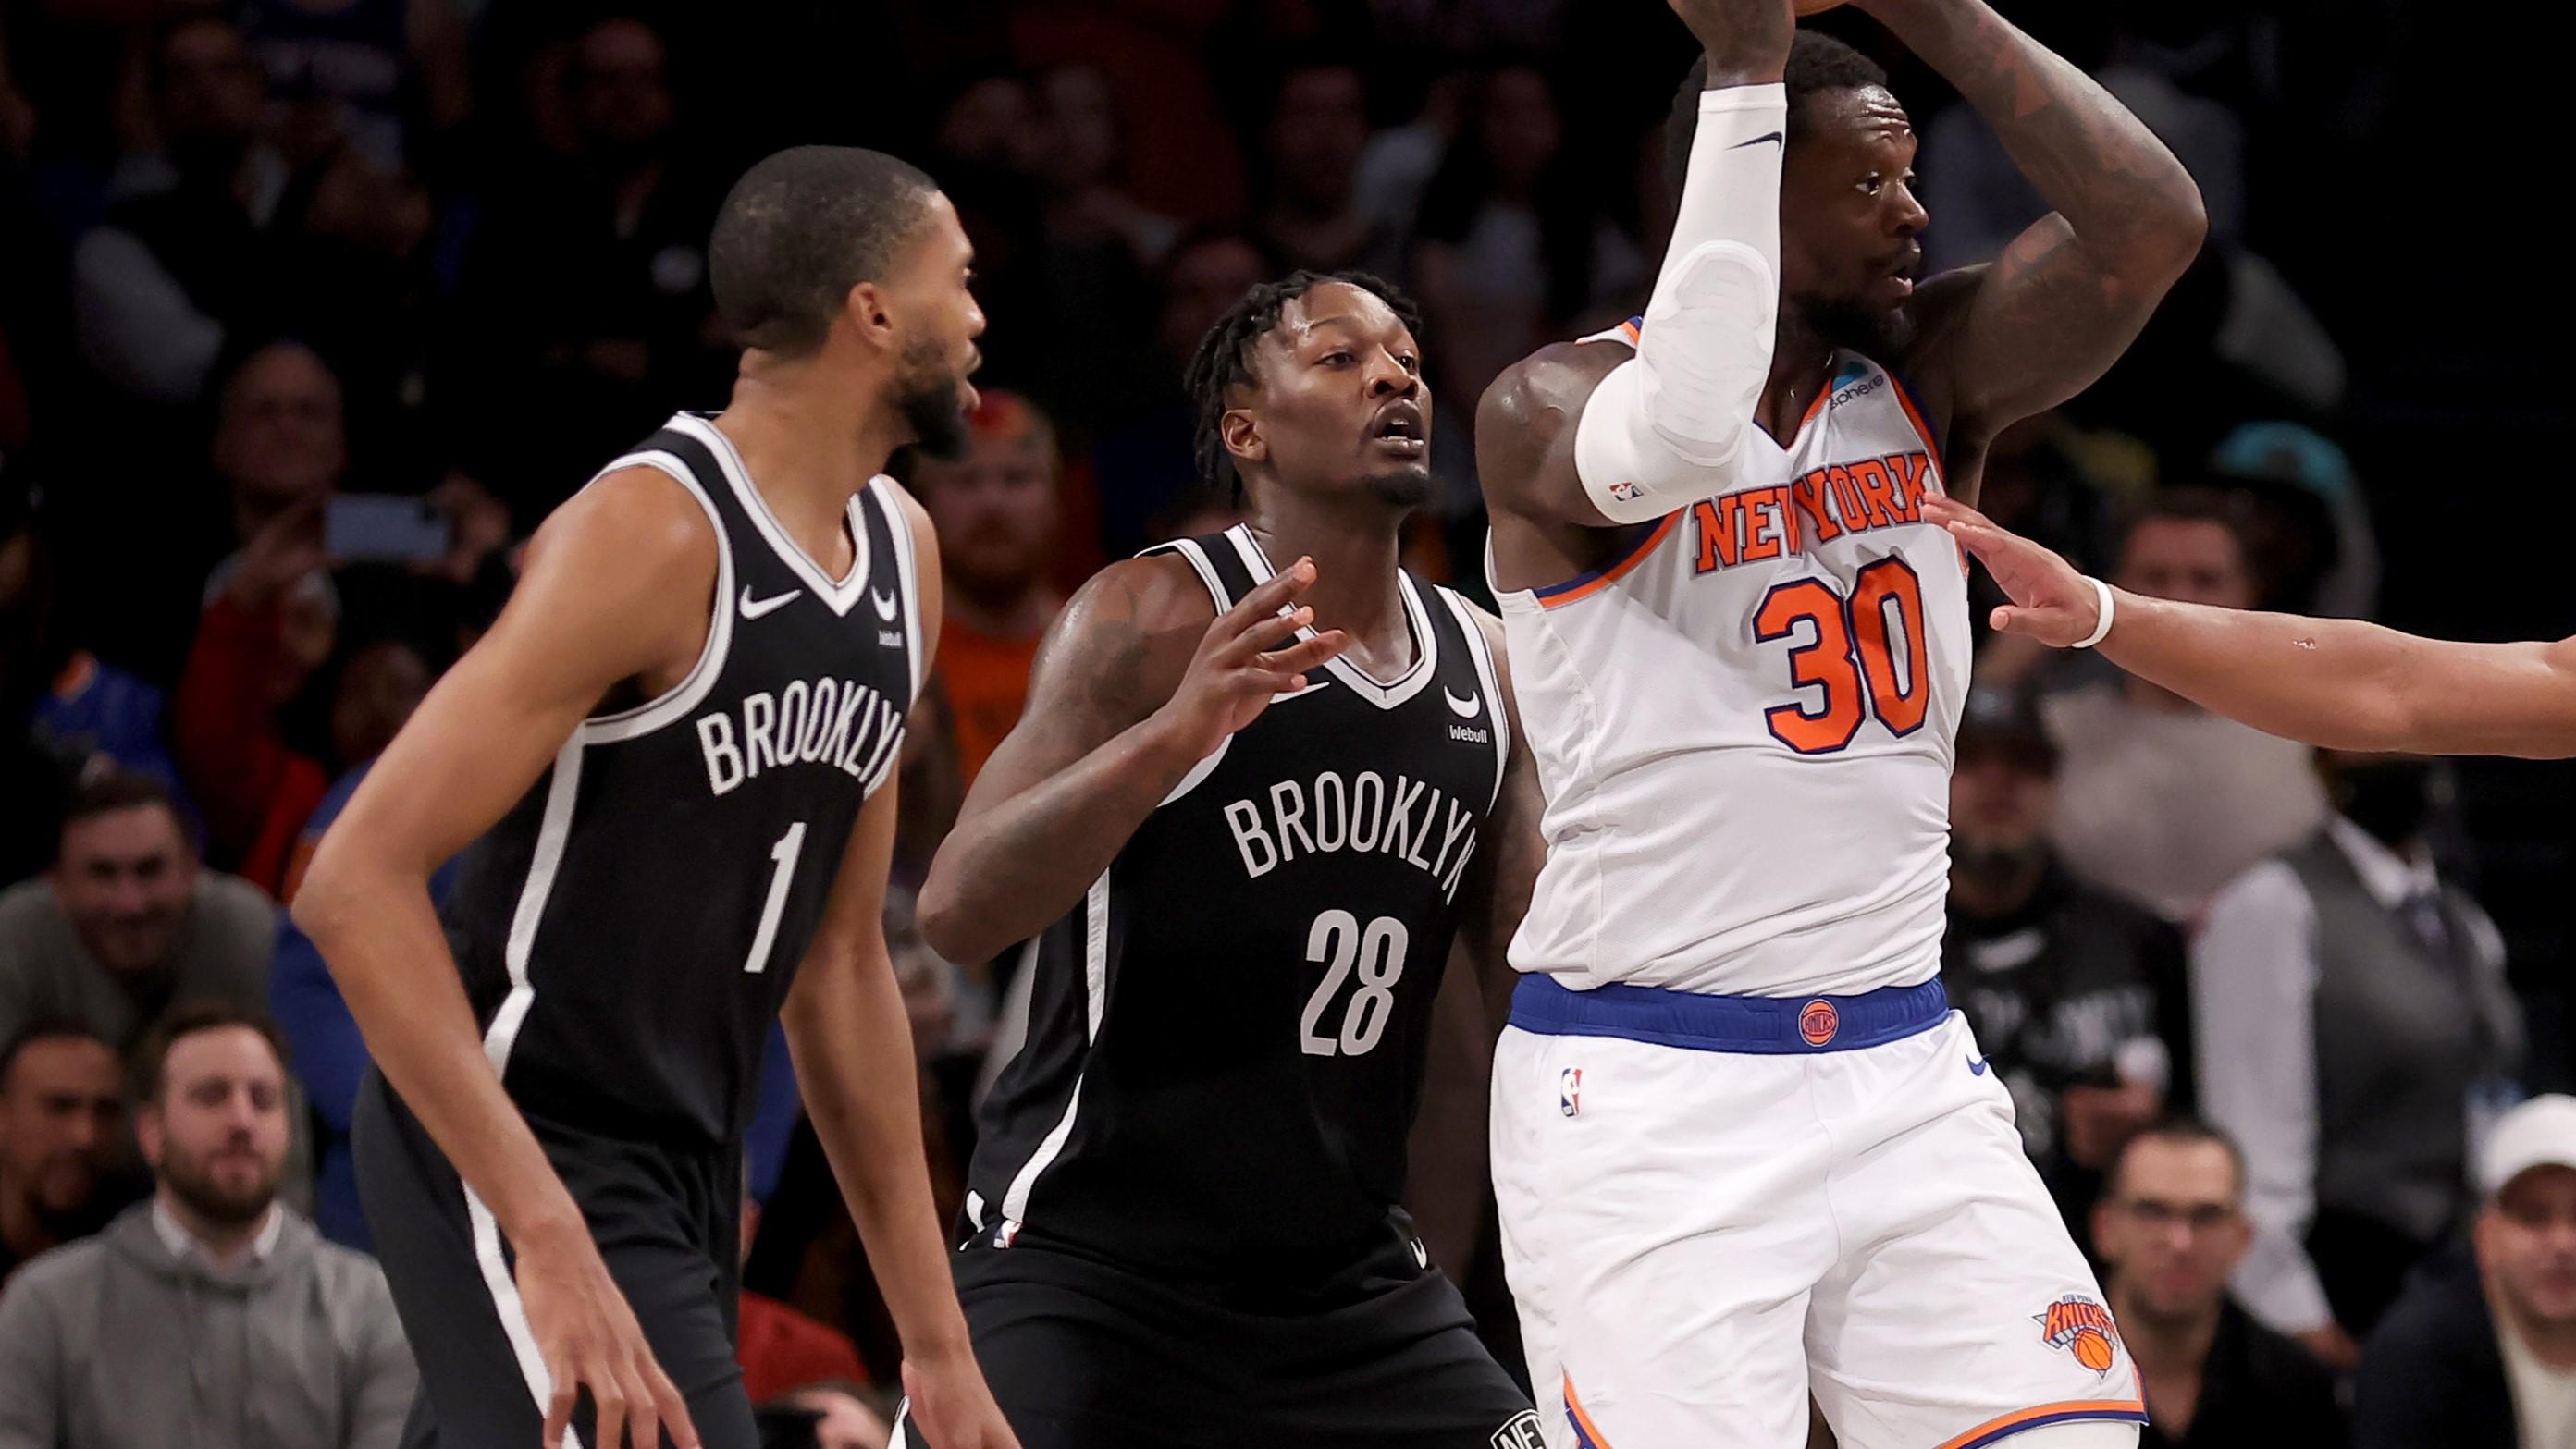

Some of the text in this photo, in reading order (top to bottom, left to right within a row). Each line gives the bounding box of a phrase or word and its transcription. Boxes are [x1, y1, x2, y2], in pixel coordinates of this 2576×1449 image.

[1792, 450, 1932, 545] YORK
[1753, 554, 1930, 755] 30
[1448, 724, 1488, 744] Webull
[743, 822, 807, 973] 1
[1300, 909, 1409, 1057] 28
